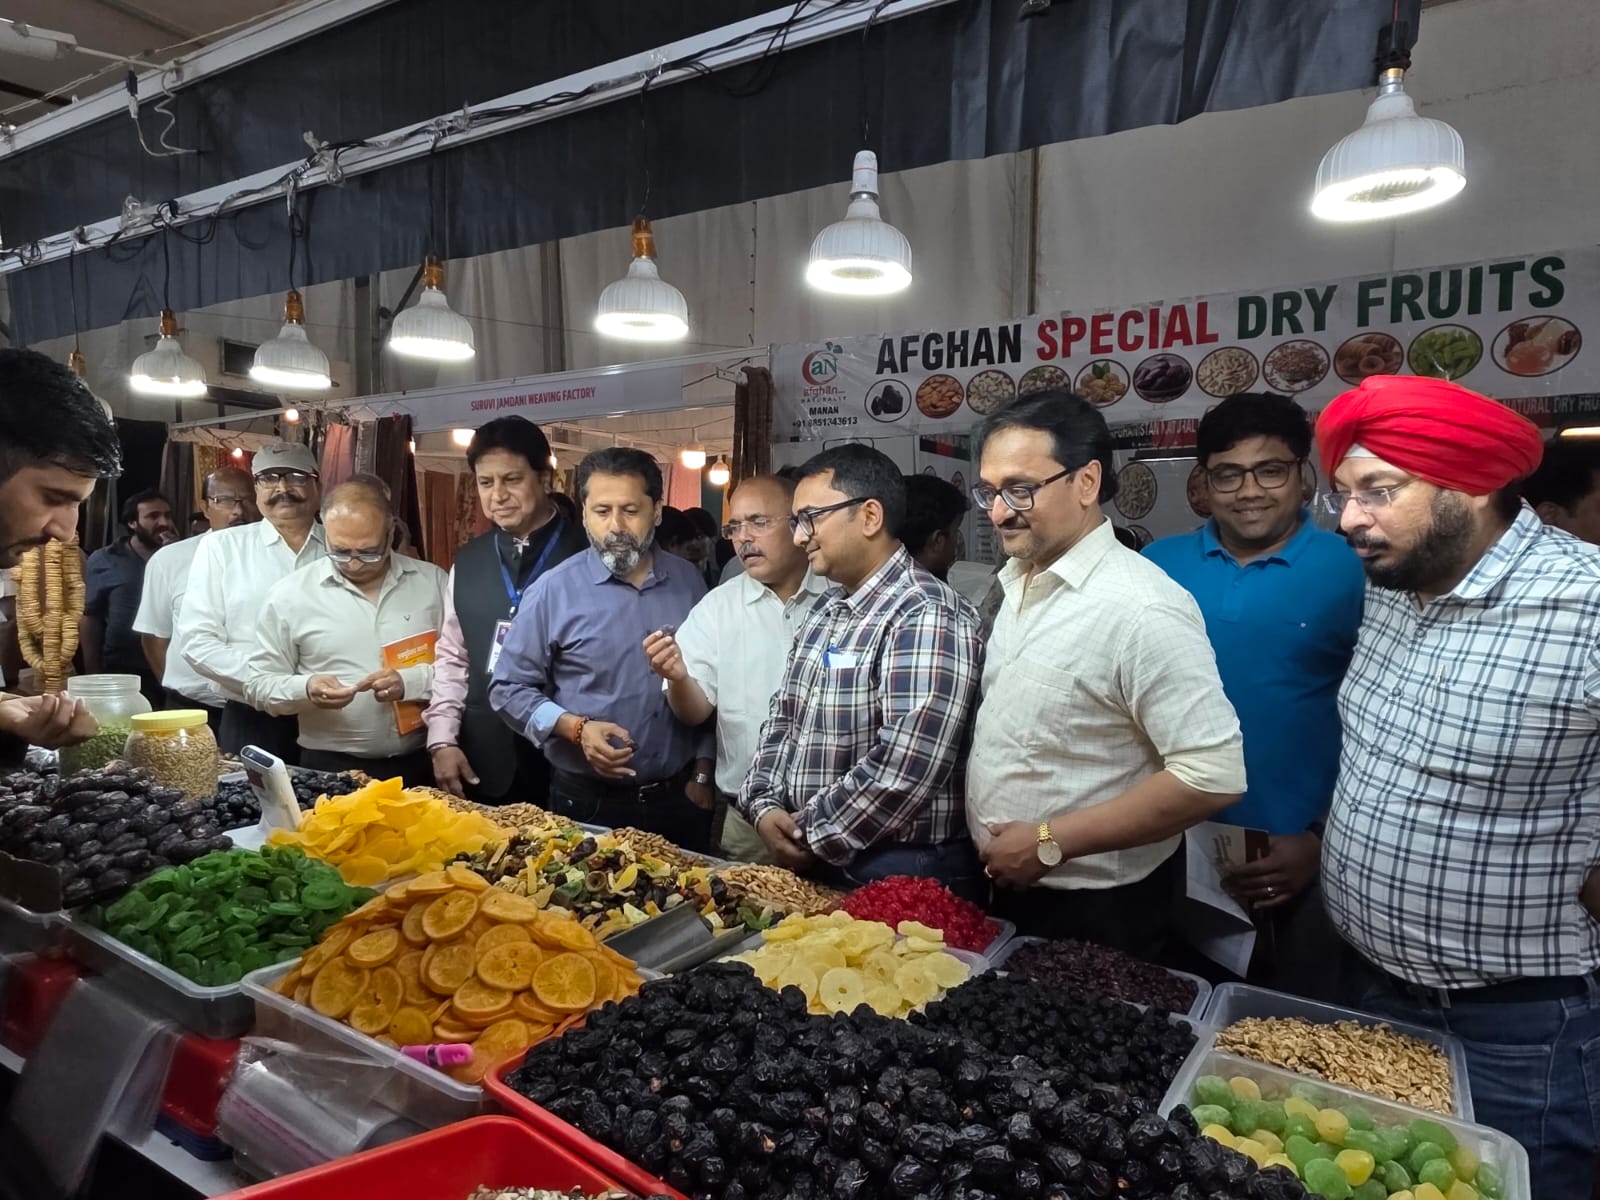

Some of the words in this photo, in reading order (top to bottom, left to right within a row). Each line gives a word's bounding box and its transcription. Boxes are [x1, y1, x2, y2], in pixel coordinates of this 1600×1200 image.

[876, 323, 1022, 375] AFGHAN
[1036, 301, 1219, 361] SPECIAL
[1236, 284, 1338, 339] DRY
[1356, 256, 1566, 327] FRUITS
[470, 399, 495, 411] SURUVI
[496, 394, 527, 410] JAMDANI
[528, 391, 561, 405] WEAVING
[562, 386, 597, 401] FACTORY
[808, 406, 839, 416] MANAN
